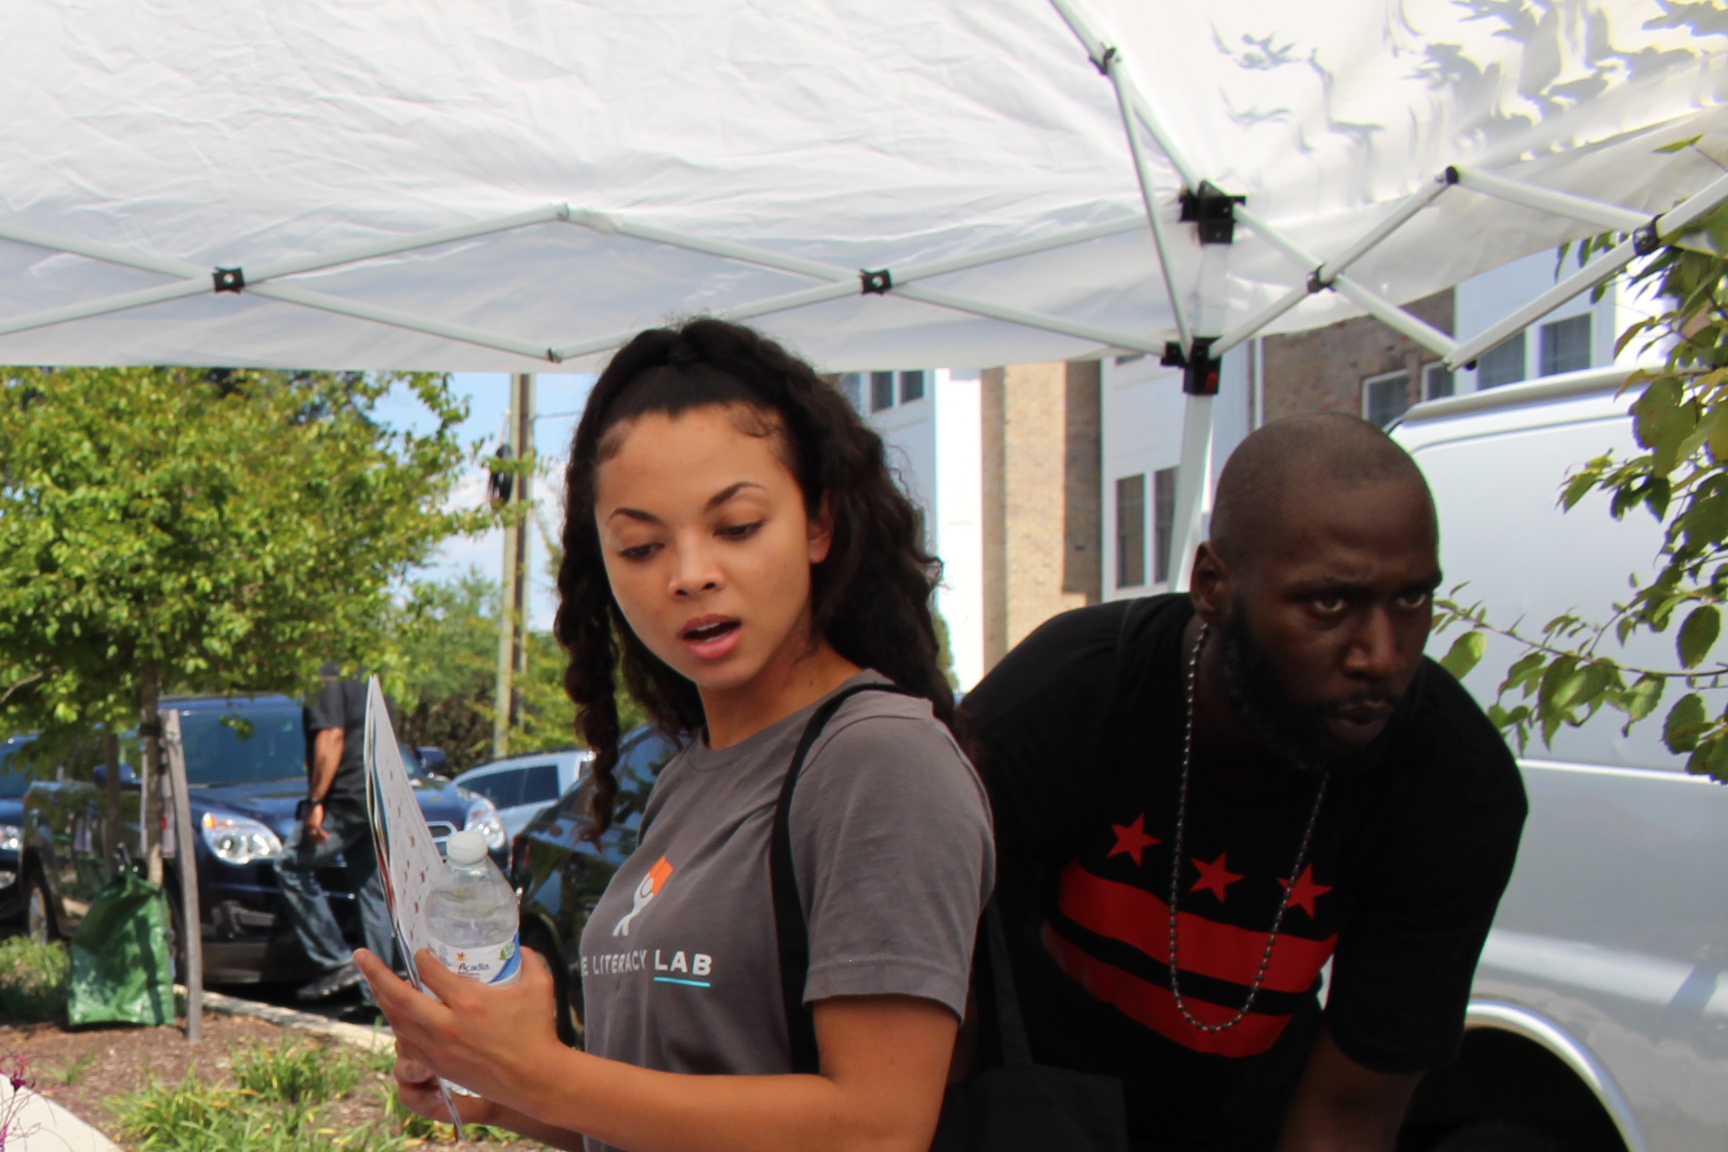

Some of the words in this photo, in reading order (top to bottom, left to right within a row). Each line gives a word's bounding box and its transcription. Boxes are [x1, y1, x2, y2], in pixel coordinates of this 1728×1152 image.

[459, 963, 490, 972] Acadia
[593, 950, 647, 975] LITERACY
[655, 949, 712, 976] LAB
